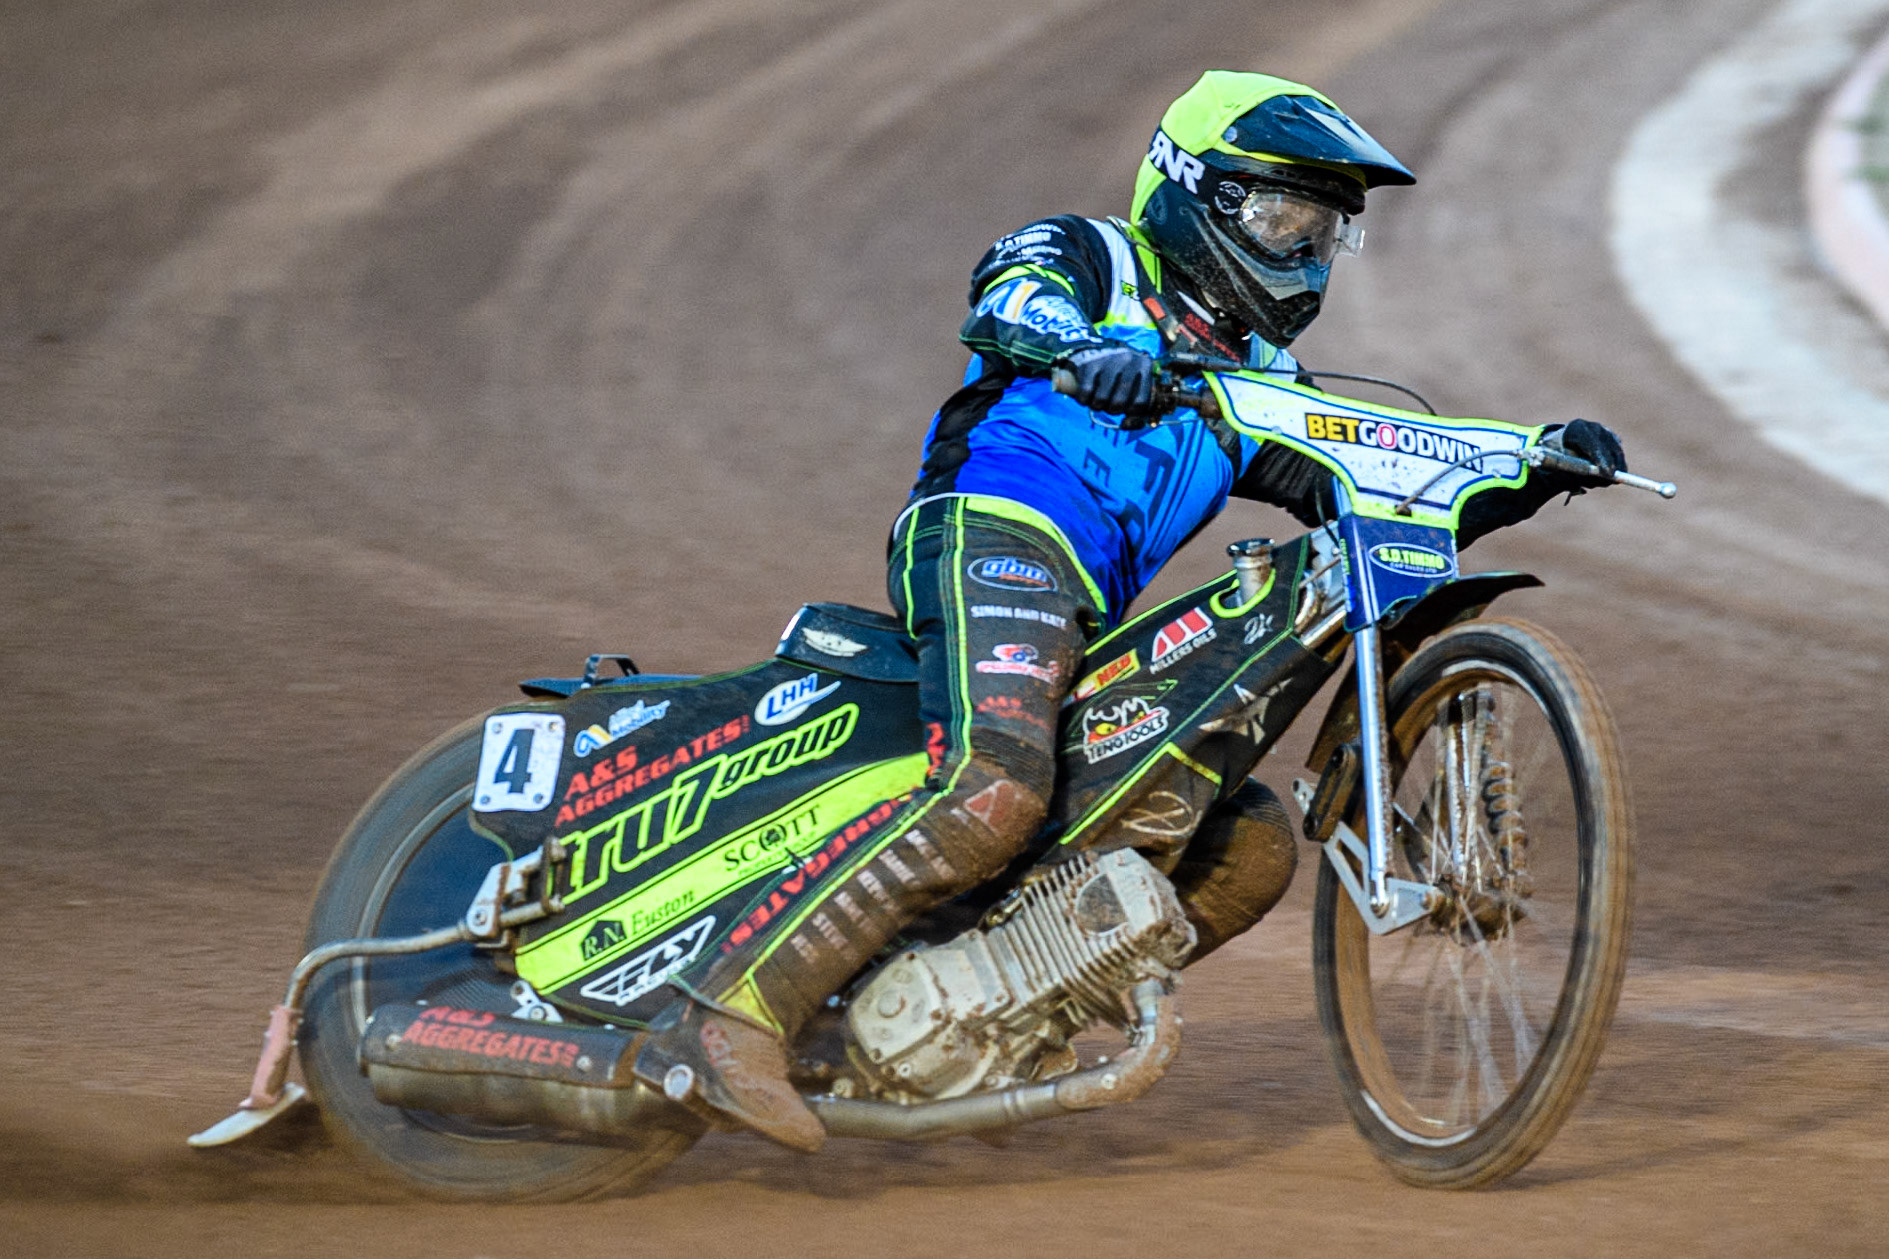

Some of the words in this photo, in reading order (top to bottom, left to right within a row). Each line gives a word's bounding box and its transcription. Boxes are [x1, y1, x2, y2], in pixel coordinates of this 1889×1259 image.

[1149, 641, 1194, 674] MILLERS
[1192, 627, 1217, 648] OILS
[493, 729, 535, 794] 4
[554, 718, 742, 828] AGGREGATES
[565, 746, 637, 799] A&S
[724, 803, 820, 871] SCOTT
[401, 1020, 560, 1066] AGGREGATES
